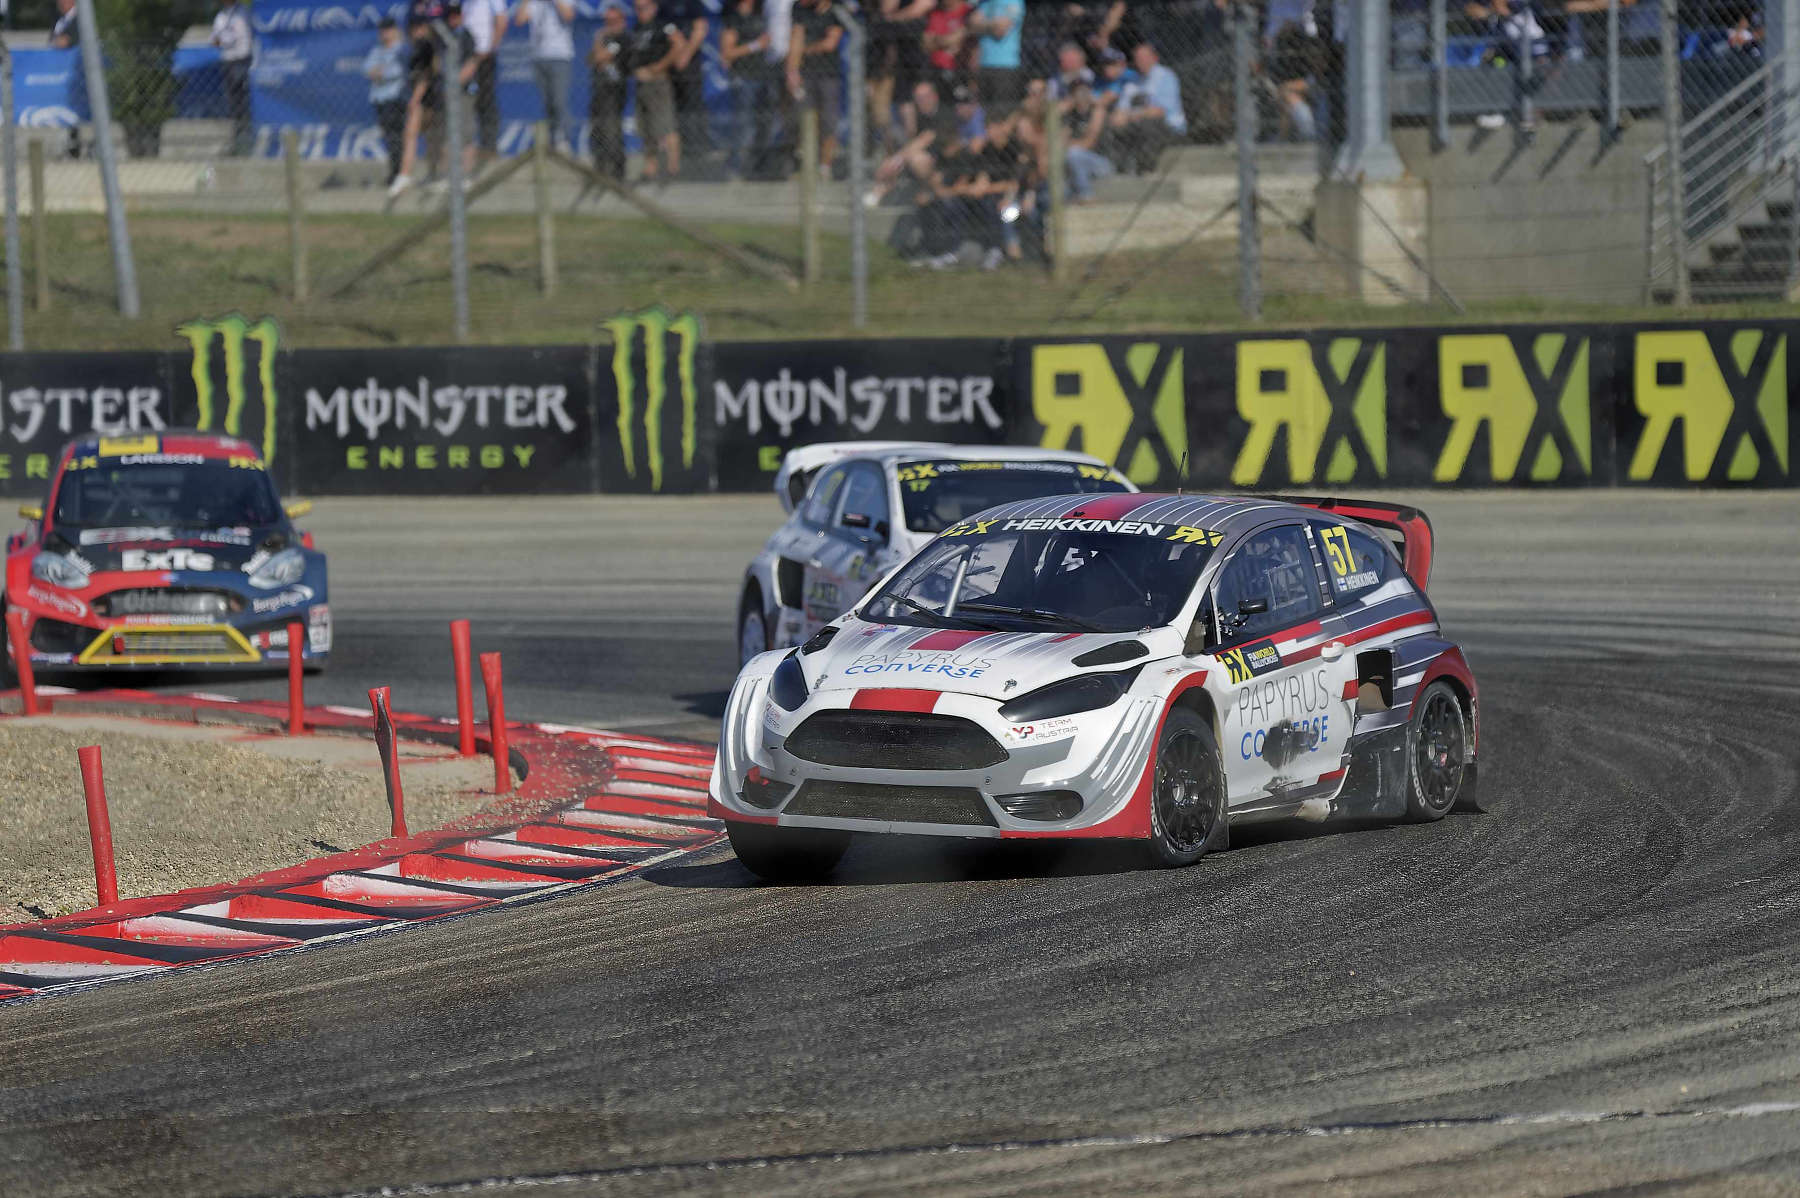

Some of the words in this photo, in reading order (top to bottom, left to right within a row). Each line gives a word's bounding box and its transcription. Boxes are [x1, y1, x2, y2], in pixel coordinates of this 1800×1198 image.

[0, 380, 167, 443] STER
[306, 376, 577, 441] MONSTER
[714, 367, 1002, 437] MONSTER
[1231, 337, 1387, 484] RX
[1433, 333, 1592, 483] RX
[1628, 329, 1788, 482] RX
[346, 445, 536, 470] ENERGY
[1002, 518, 1165, 537] HEIKKINEN
[1166, 525, 1225, 548] RX
[1320, 526, 1357, 576] 57
[1346, 570, 1379, 590] HEIKKINEN
[844, 663, 986, 679] CONVERSE
[852, 651, 998, 670] PAPYRUS
[1255, 646, 1275, 660] WORLD
[1239, 669, 1329, 727] PAPYRUS
[1035, 726, 1079, 740] AUSTRIA
[1040, 718, 1073, 729] TEAM
[1240, 714, 1329, 761] CORSE
